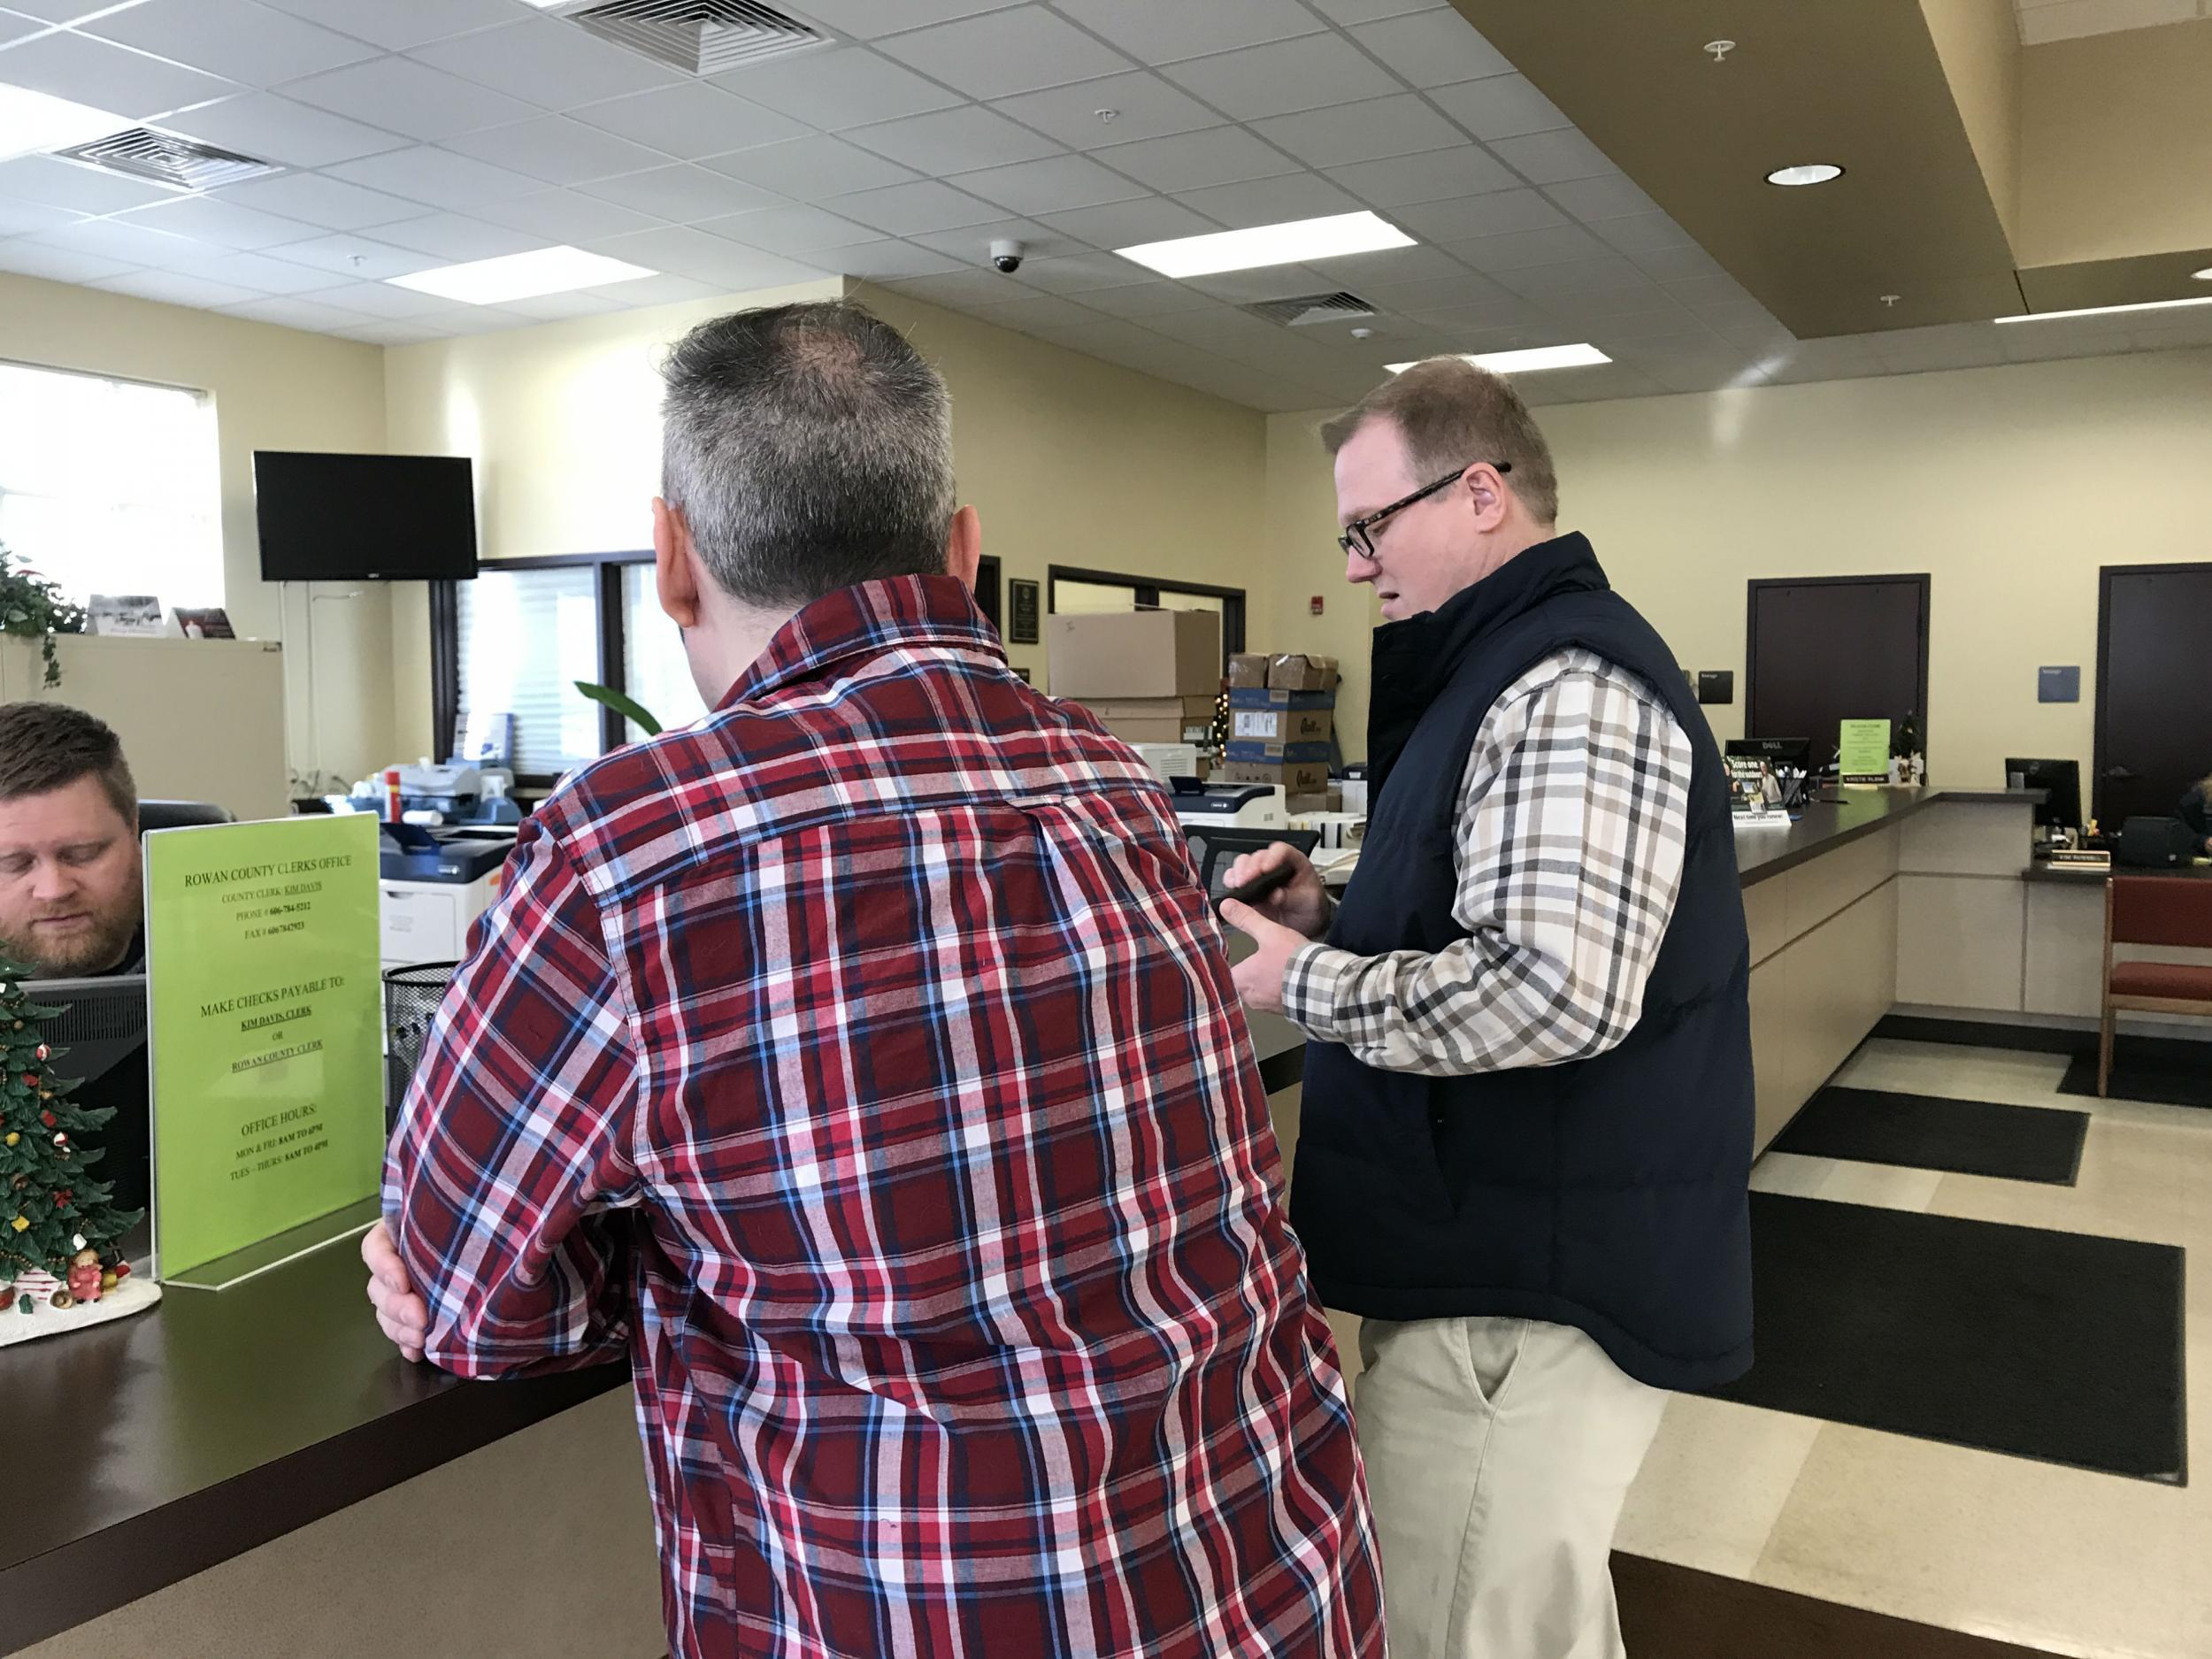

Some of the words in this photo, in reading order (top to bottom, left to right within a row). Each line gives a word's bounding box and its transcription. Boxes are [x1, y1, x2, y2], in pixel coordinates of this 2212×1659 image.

[185, 870, 229, 887] ROWAN
[231, 864, 275, 881] COUNTY
[278, 858, 317, 875] CLERKS
[319, 855, 352, 870] OFFICE
[221, 891, 256, 903] COUNTY
[284, 884, 299, 896] KIM
[300, 880, 322, 894] DAVIS
[235, 909, 263, 921] PHONE
[244, 928, 261, 940] FAX
[200, 999, 235, 1018] MAKE
[236, 989, 280, 1010] CHECKS
[280, 979, 327, 1001] PAYABLE
[329, 975, 345, 989] TO:
[241, 1018, 258, 1032] KIM
[285, 1005, 312, 1021] CLERK
[272, 1031, 283, 1041] OR
[232, 1056, 263, 1073] ROWAN
[263, 1047, 295, 1064] COUNTY
[296, 1040, 324, 1056] CLERK
[241, 1114, 278, 1136] OFFICE
[280, 1103, 318, 1125] HOURS:
[235, 1147, 255, 1160] MON
[256, 1143, 262, 1153] &
[296, 1128, 308, 1140] TO
[229, 1167, 250, 1181] TUES
[303, 1145, 313, 1156] TO
